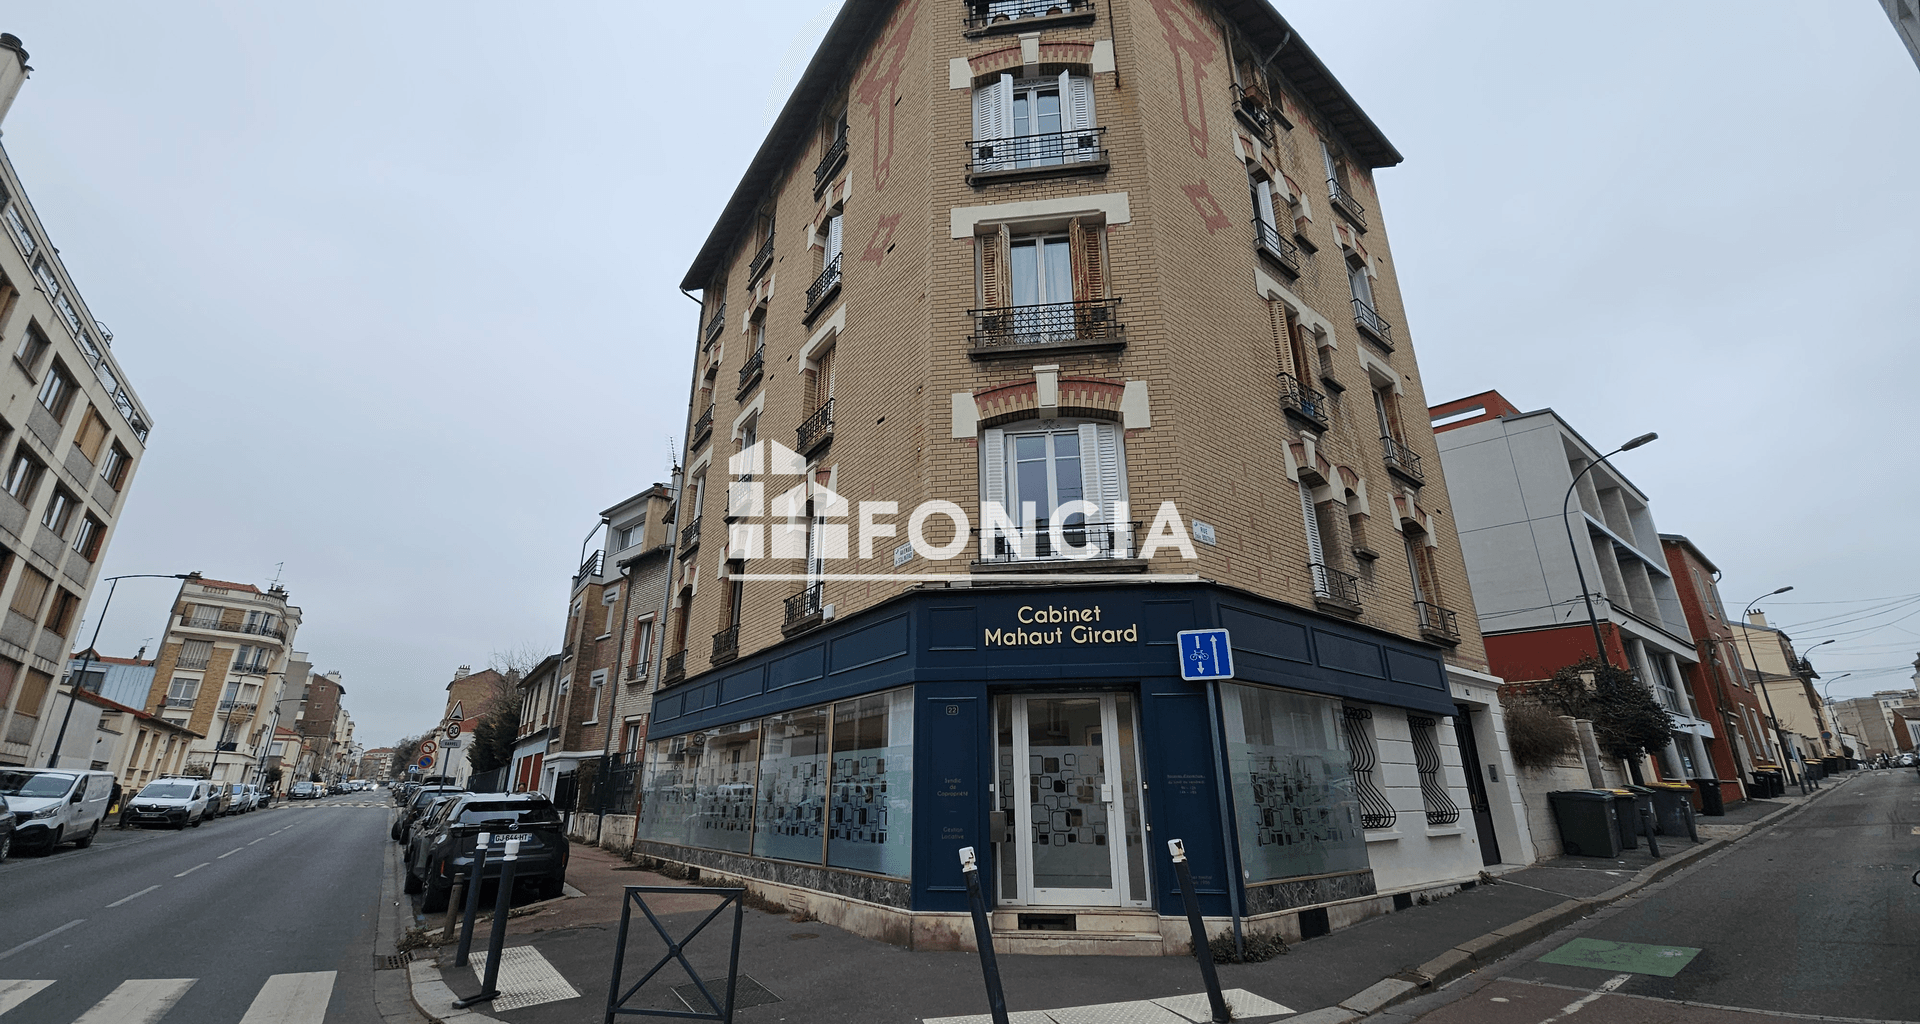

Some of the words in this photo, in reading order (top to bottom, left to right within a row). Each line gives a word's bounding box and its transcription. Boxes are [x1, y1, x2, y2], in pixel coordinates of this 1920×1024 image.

[1017, 605, 1101, 624] Cabinet
[984, 627, 1063, 646] Mahaut
[1070, 623, 1138, 644] Girard
[948, 706, 957, 714] 22
[450, 726, 459, 735] 30
